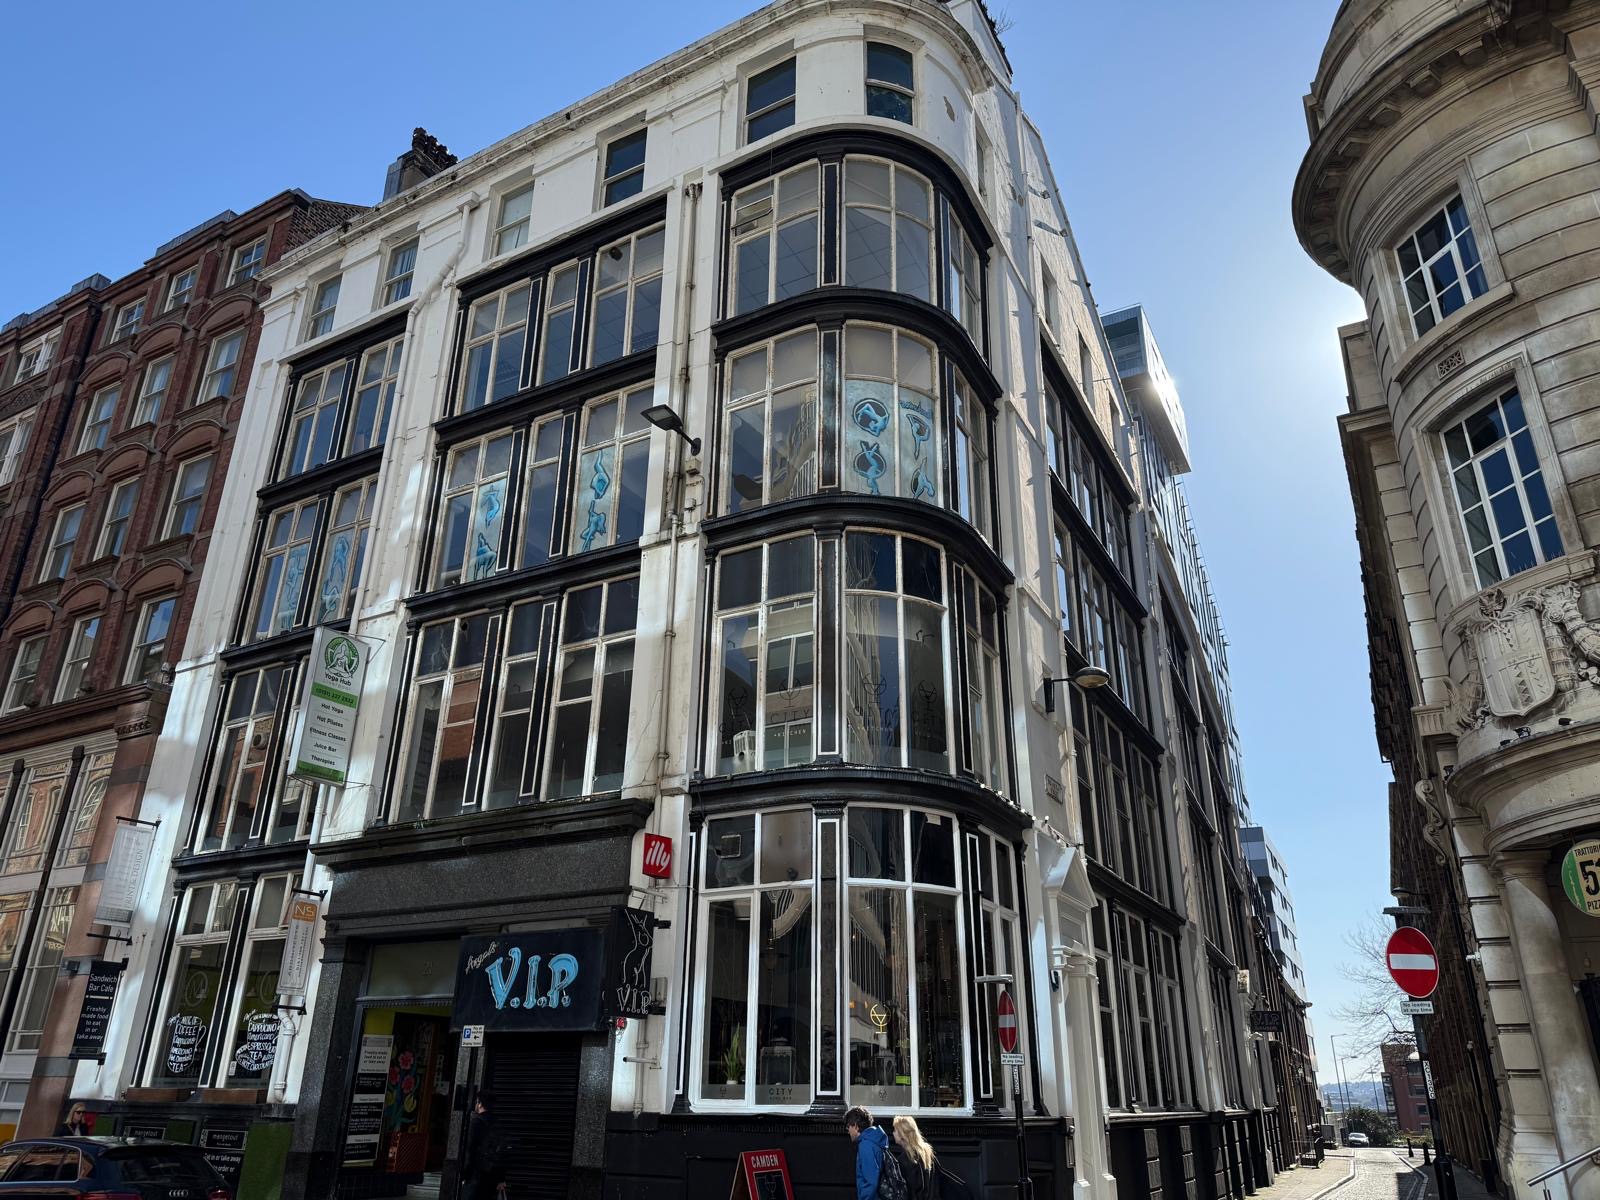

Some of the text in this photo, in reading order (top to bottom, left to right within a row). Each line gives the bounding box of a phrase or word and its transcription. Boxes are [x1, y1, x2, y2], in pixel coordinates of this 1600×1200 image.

[324, 672, 338, 682] Yoga
[340, 678, 352, 686] Hub
[327, 718, 343, 728] Pilates
[310, 727, 346, 741] Fitness Classes
[312, 755, 335, 765] Therapies
[646, 840, 670, 873] illy
[295, 904, 313, 917] NS
[90, 974, 117, 983] Sandwich
[485, 947, 578, 1009] V.I.P.
[89, 983, 100, 991] Bar
[175, 1024, 198, 1036] COFFEE
[250, 1051, 262, 1060] TEA
[173, 1063, 184, 1072] TEA
[751, 1154, 778, 1168] CAMDEN
